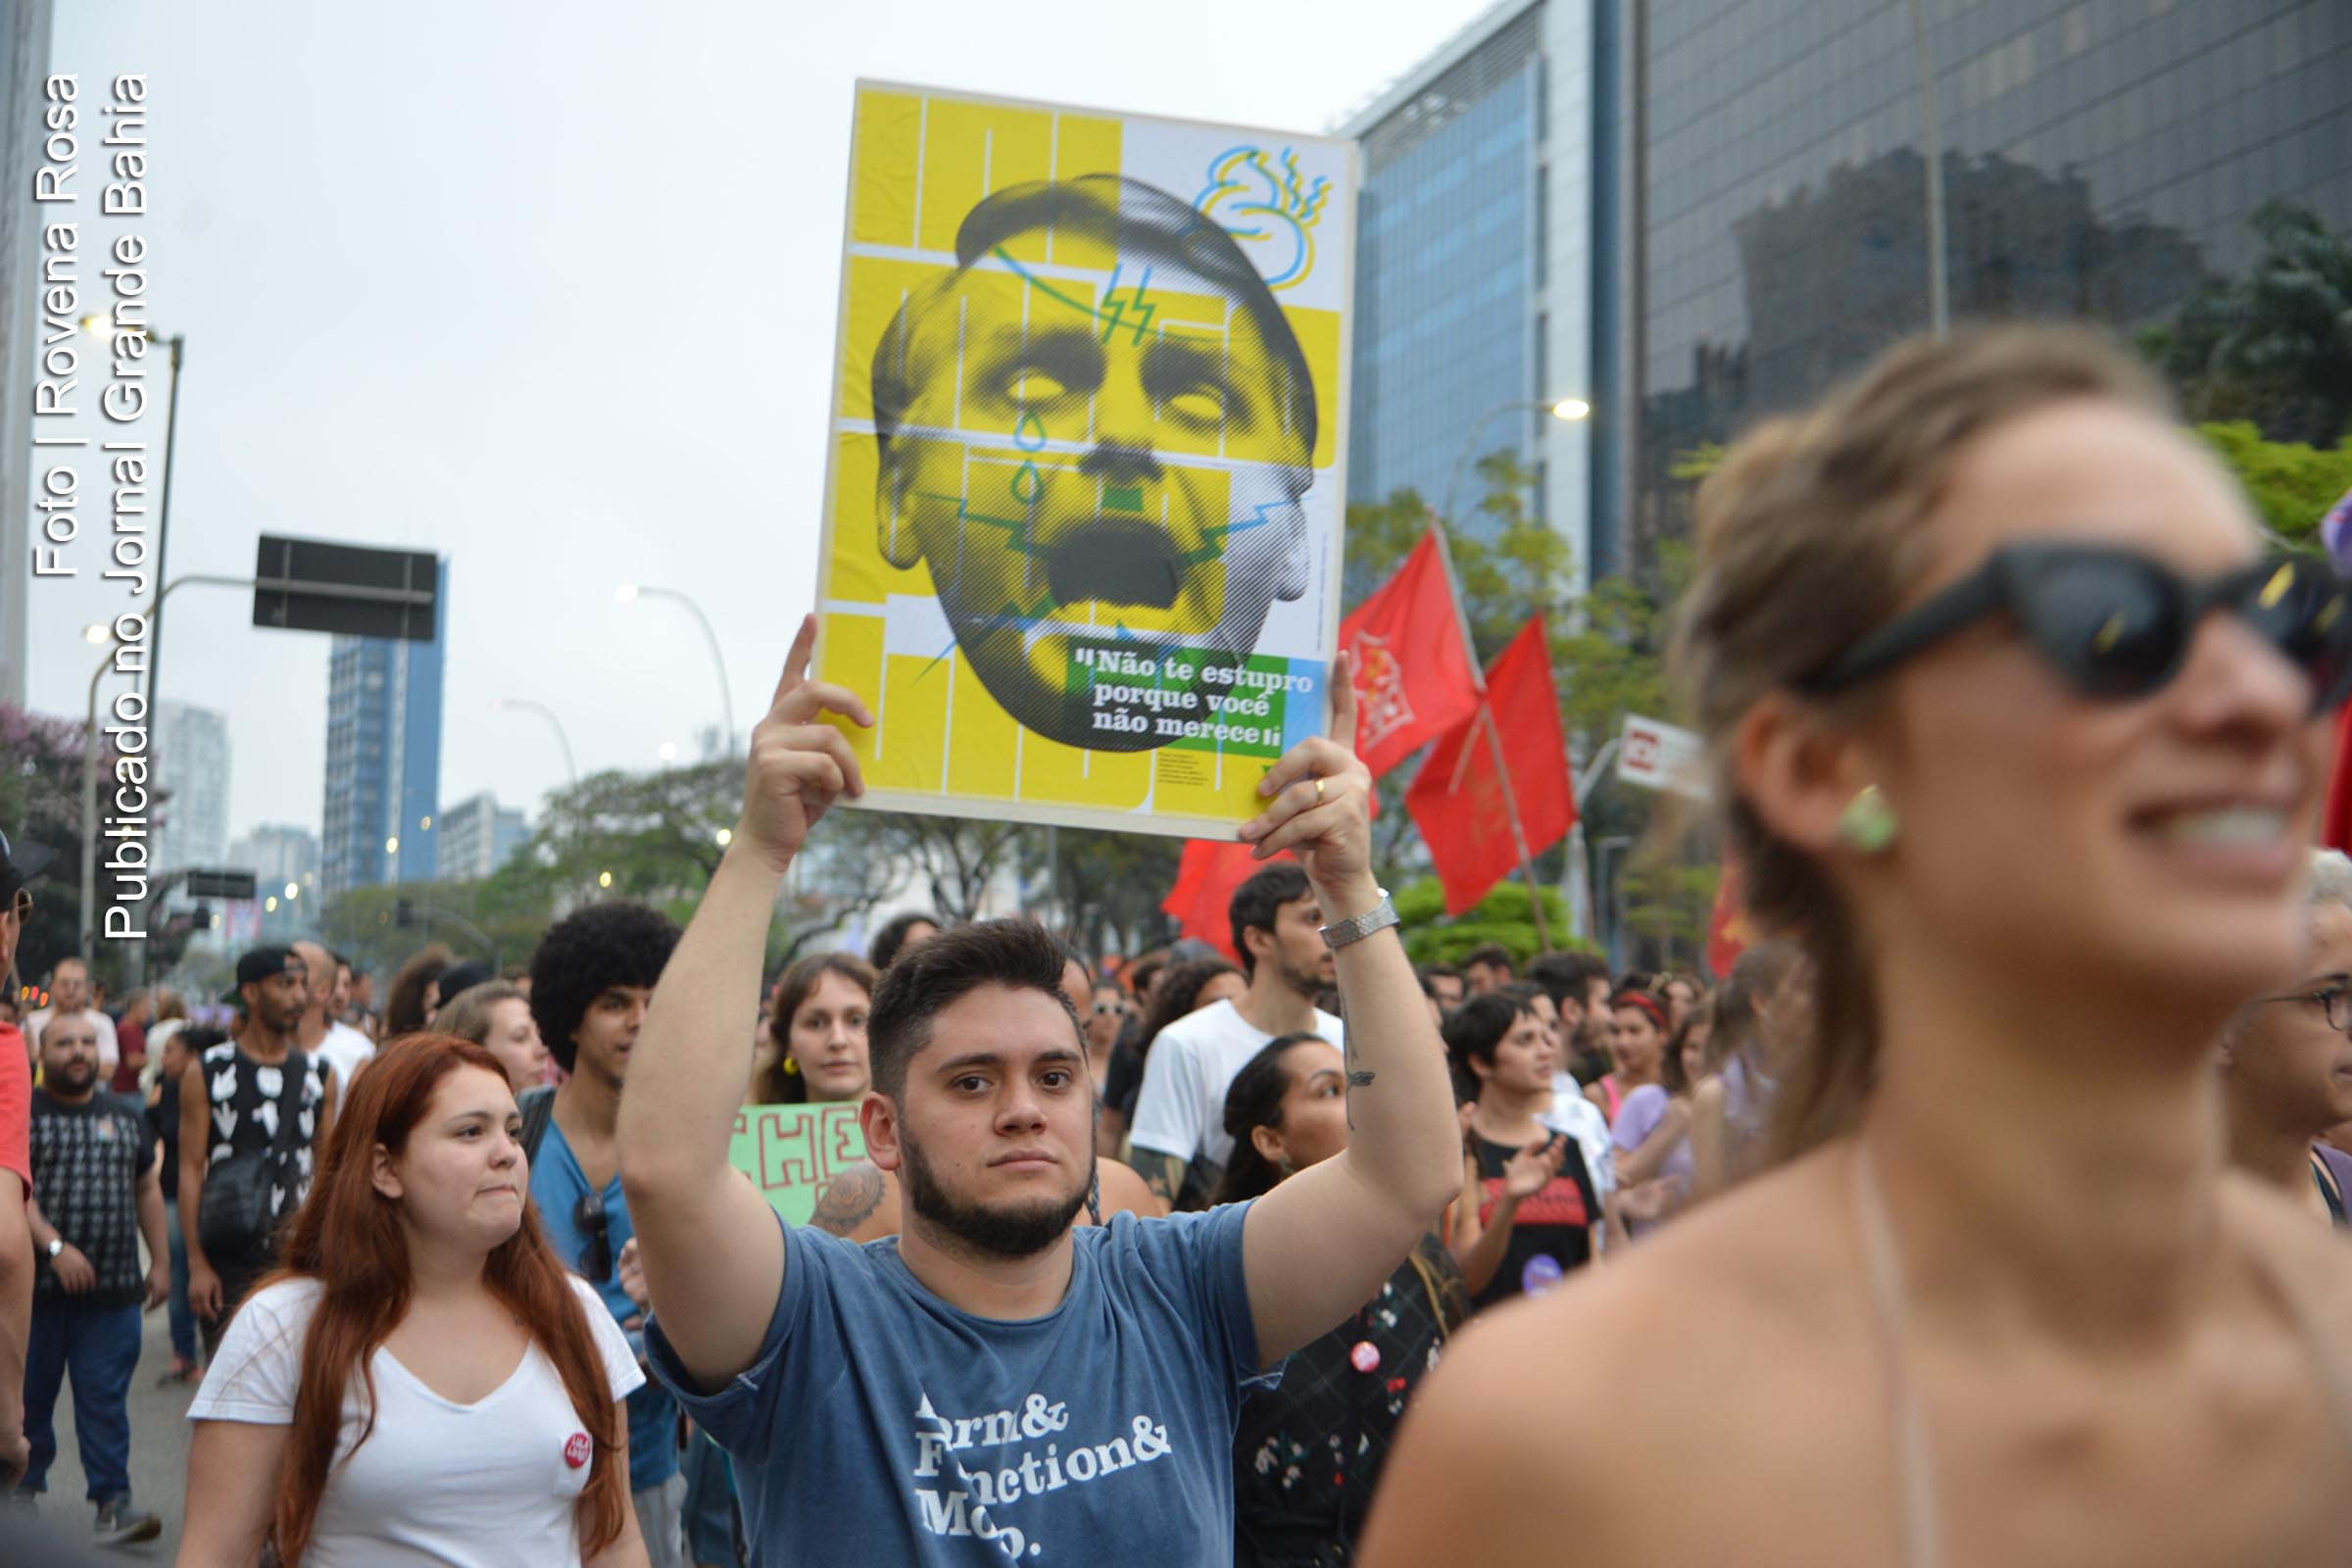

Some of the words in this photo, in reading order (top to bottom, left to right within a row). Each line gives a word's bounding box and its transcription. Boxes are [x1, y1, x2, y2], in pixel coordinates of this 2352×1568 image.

[1165, 659, 1194, 680] te
[1201, 663, 1313, 695] estupro
[1092, 683, 1199, 711] porque
[1205, 692, 1270, 716] você
[1093, 708, 1148, 733] não
[913, 1414, 1172, 1507] Fnction&
